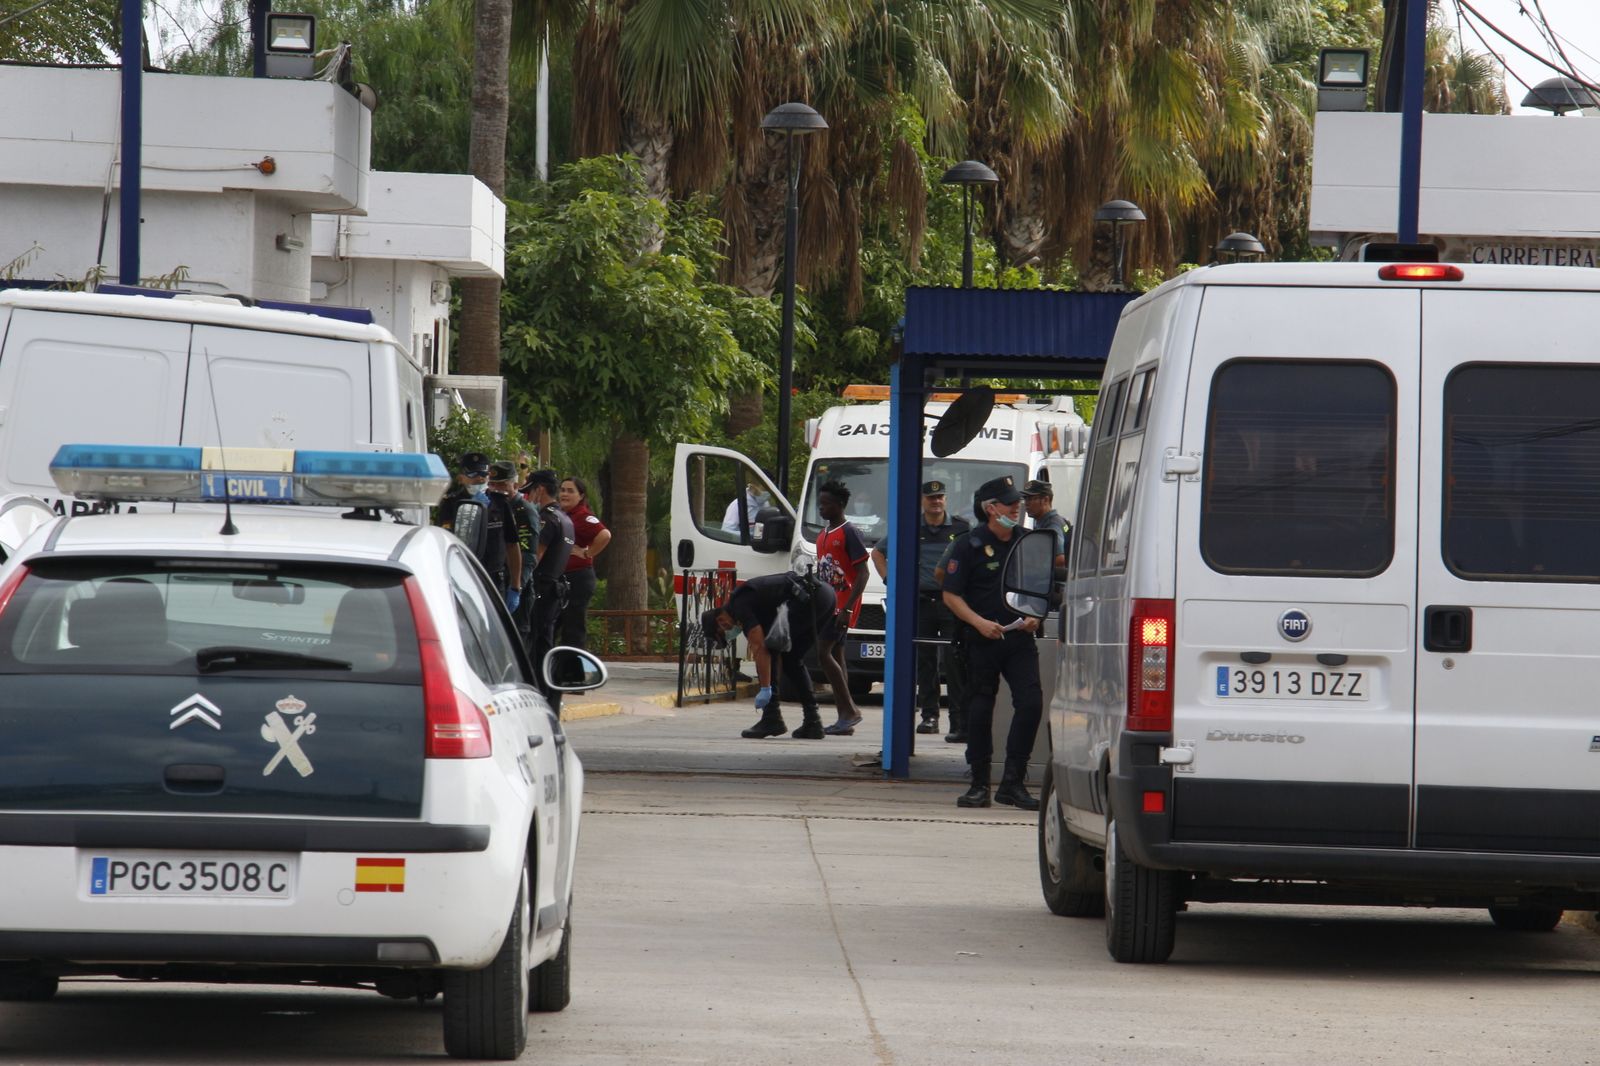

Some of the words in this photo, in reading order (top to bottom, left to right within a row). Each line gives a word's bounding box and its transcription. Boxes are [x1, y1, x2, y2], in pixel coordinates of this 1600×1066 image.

[1472, 246, 1595, 268] CARRETERA
[227, 479, 268, 497] CIVIL
[1283, 619, 1307, 631] FIAT
[867, 645, 886, 657] 39
[1233, 670, 1302, 695] 3913
[1311, 672, 1363, 697] DZZ
[1206, 730, 1306, 744] Ducato
